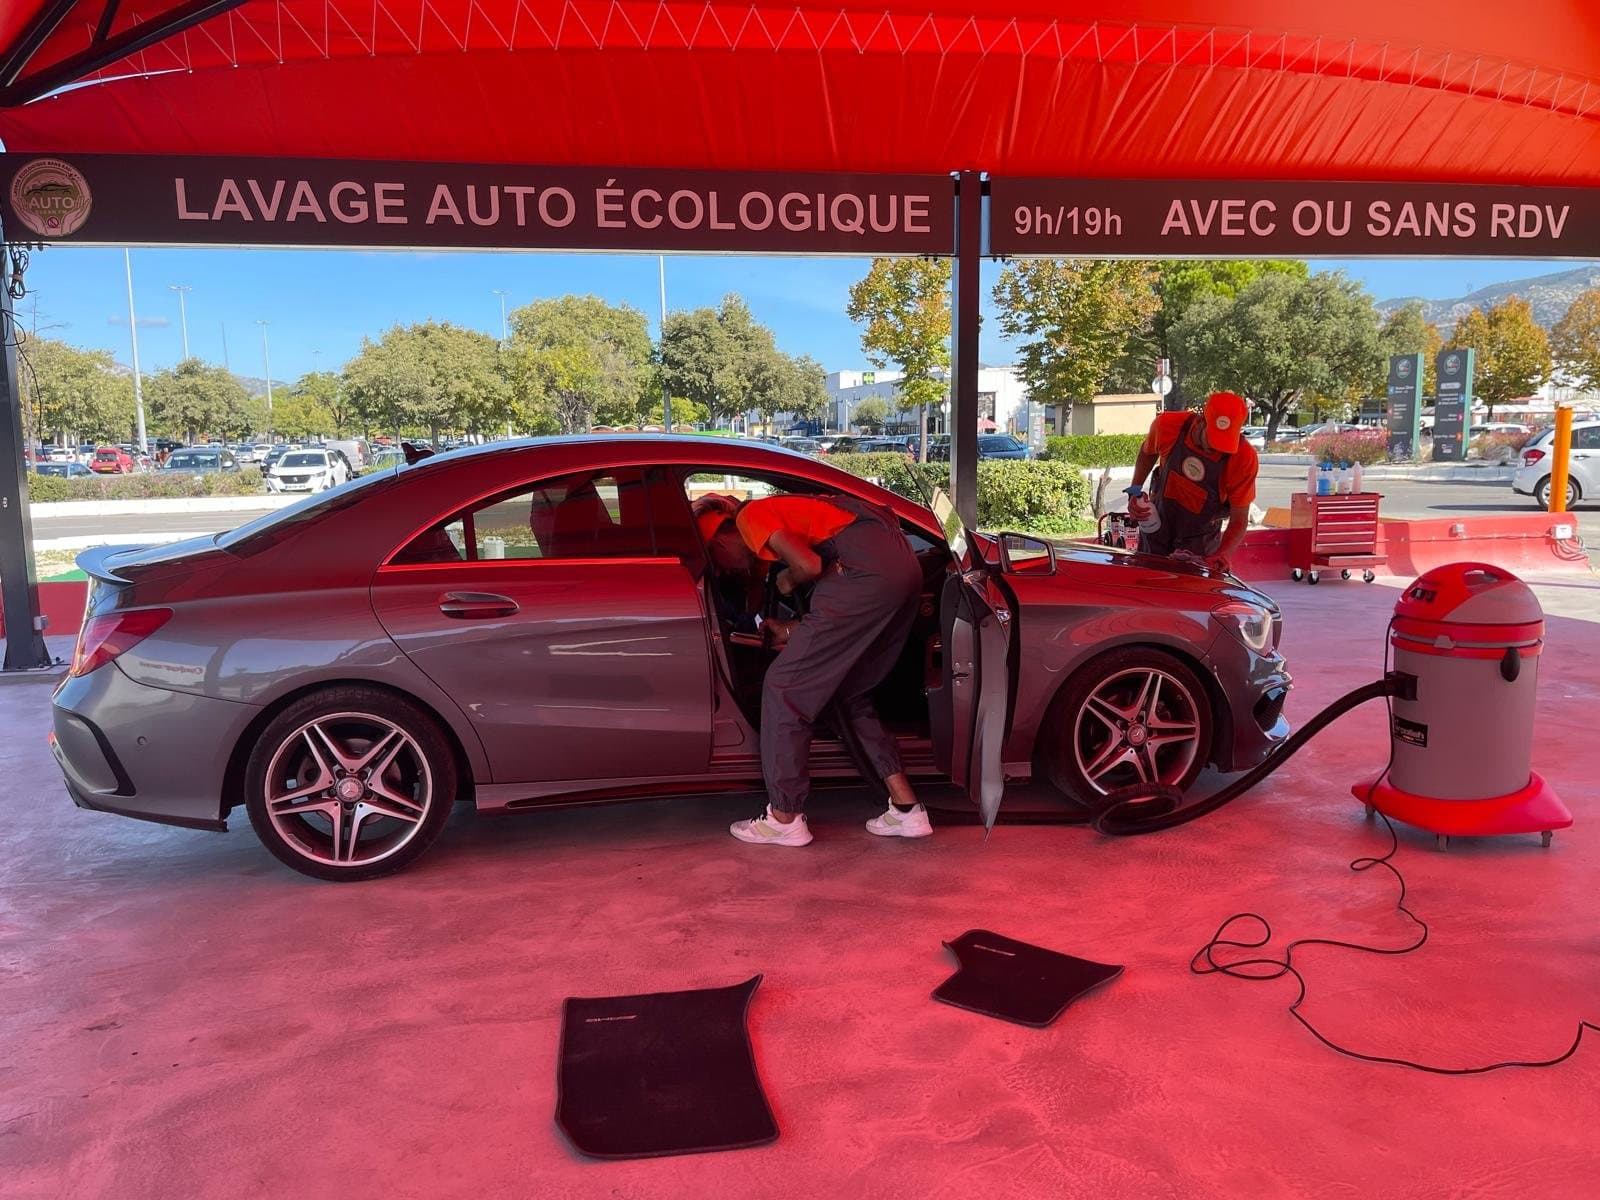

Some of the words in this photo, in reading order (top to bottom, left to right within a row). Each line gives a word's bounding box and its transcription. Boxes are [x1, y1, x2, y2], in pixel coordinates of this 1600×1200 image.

[29, 196, 75, 209] AUTO
[175, 178, 407, 224] LAVAGE
[426, 184, 576, 227] AUTO
[596, 178, 931, 235] ÉCOLOGIQUE
[1161, 199, 1277, 236] AVEC
[1292, 199, 1352, 237] OU
[1367, 200, 1476, 238] SANS
[1491, 203, 1570, 239] RDV
[1014, 205, 1122, 236] 9h/19h
